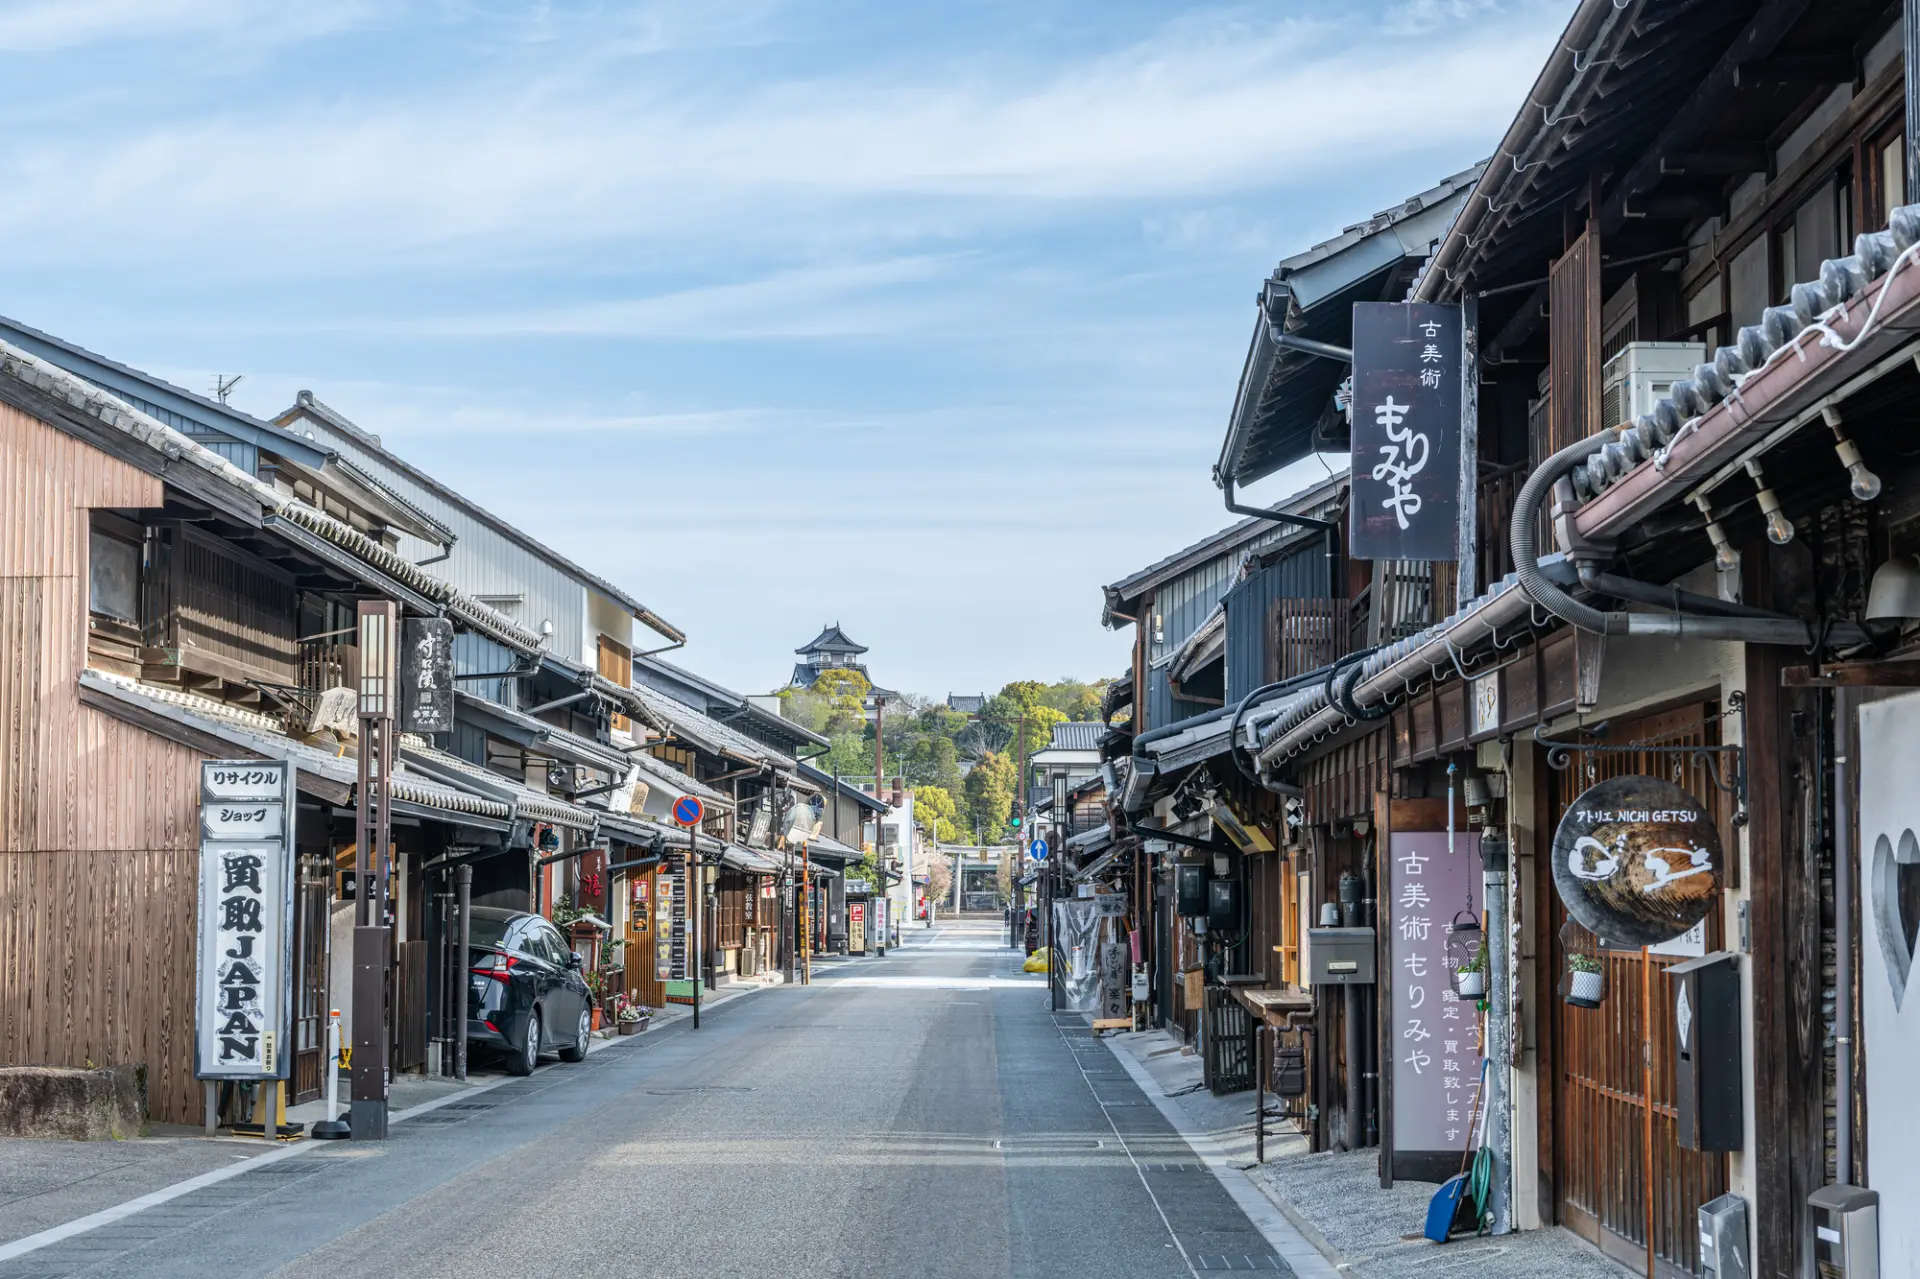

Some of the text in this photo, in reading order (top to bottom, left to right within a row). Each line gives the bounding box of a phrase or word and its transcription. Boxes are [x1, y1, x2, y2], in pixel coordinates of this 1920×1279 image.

[1419, 320, 1442, 389] 古美術
[1372, 395, 1430, 530] もりみや
[213, 771, 278, 785] リサイクル
[220, 808, 267, 822] ショップ
[1576, 810, 1697, 823] アトリエ NICHI GETSU
[853, 906, 862, 914] P
